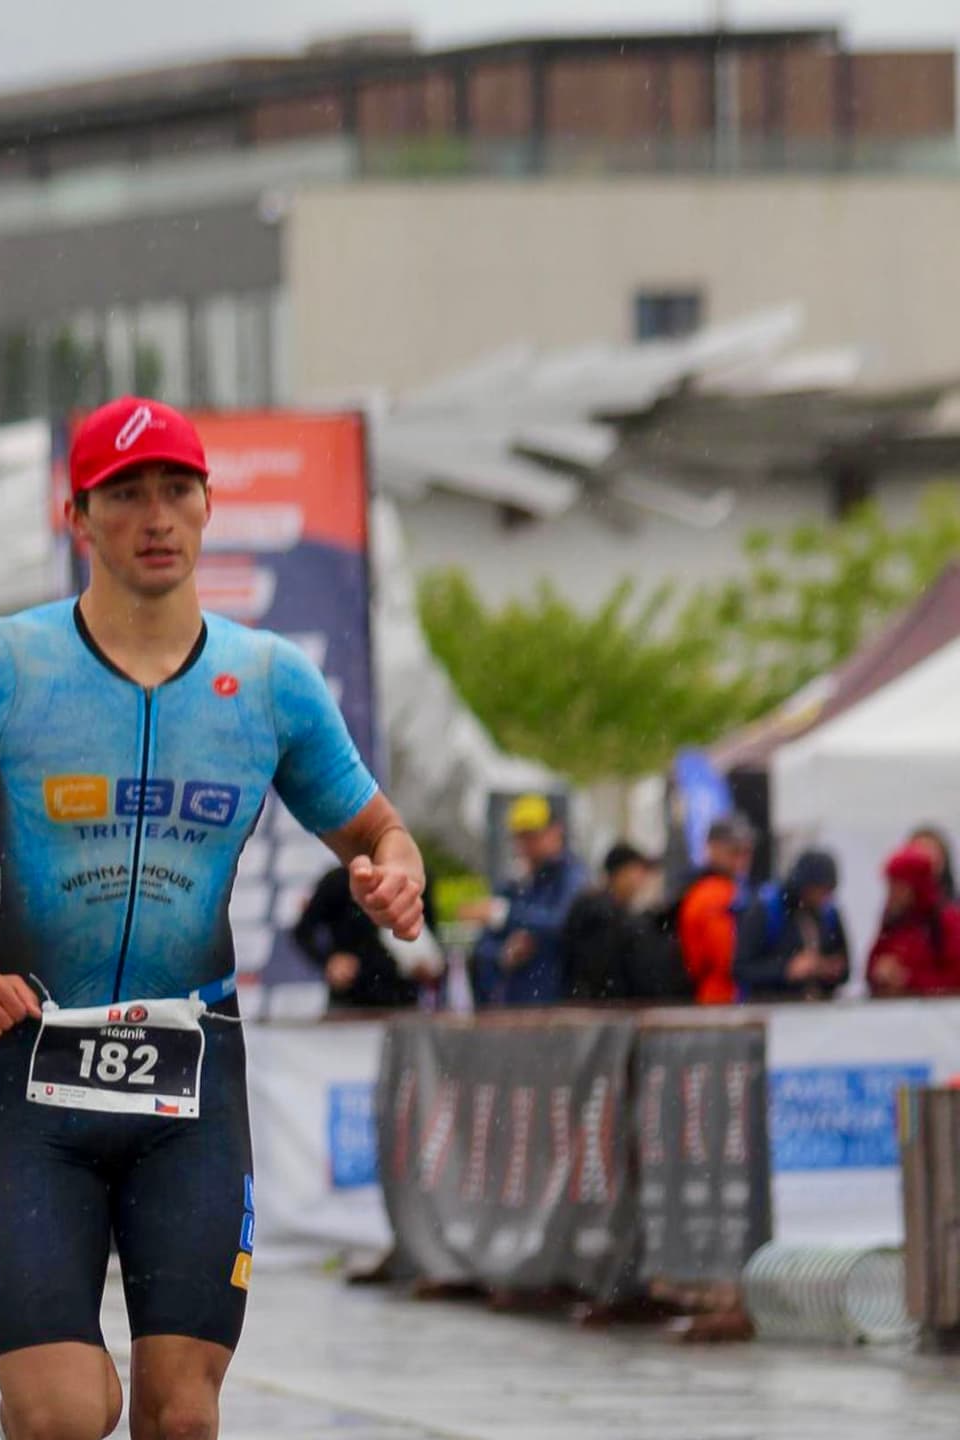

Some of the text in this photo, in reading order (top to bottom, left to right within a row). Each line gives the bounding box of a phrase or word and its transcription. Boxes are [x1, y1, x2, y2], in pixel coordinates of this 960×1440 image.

[73, 823, 209, 844] TRITEAM
[61, 864, 195, 893] VIENNA HOUSE
[79, 1039, 159, 1085] 182
